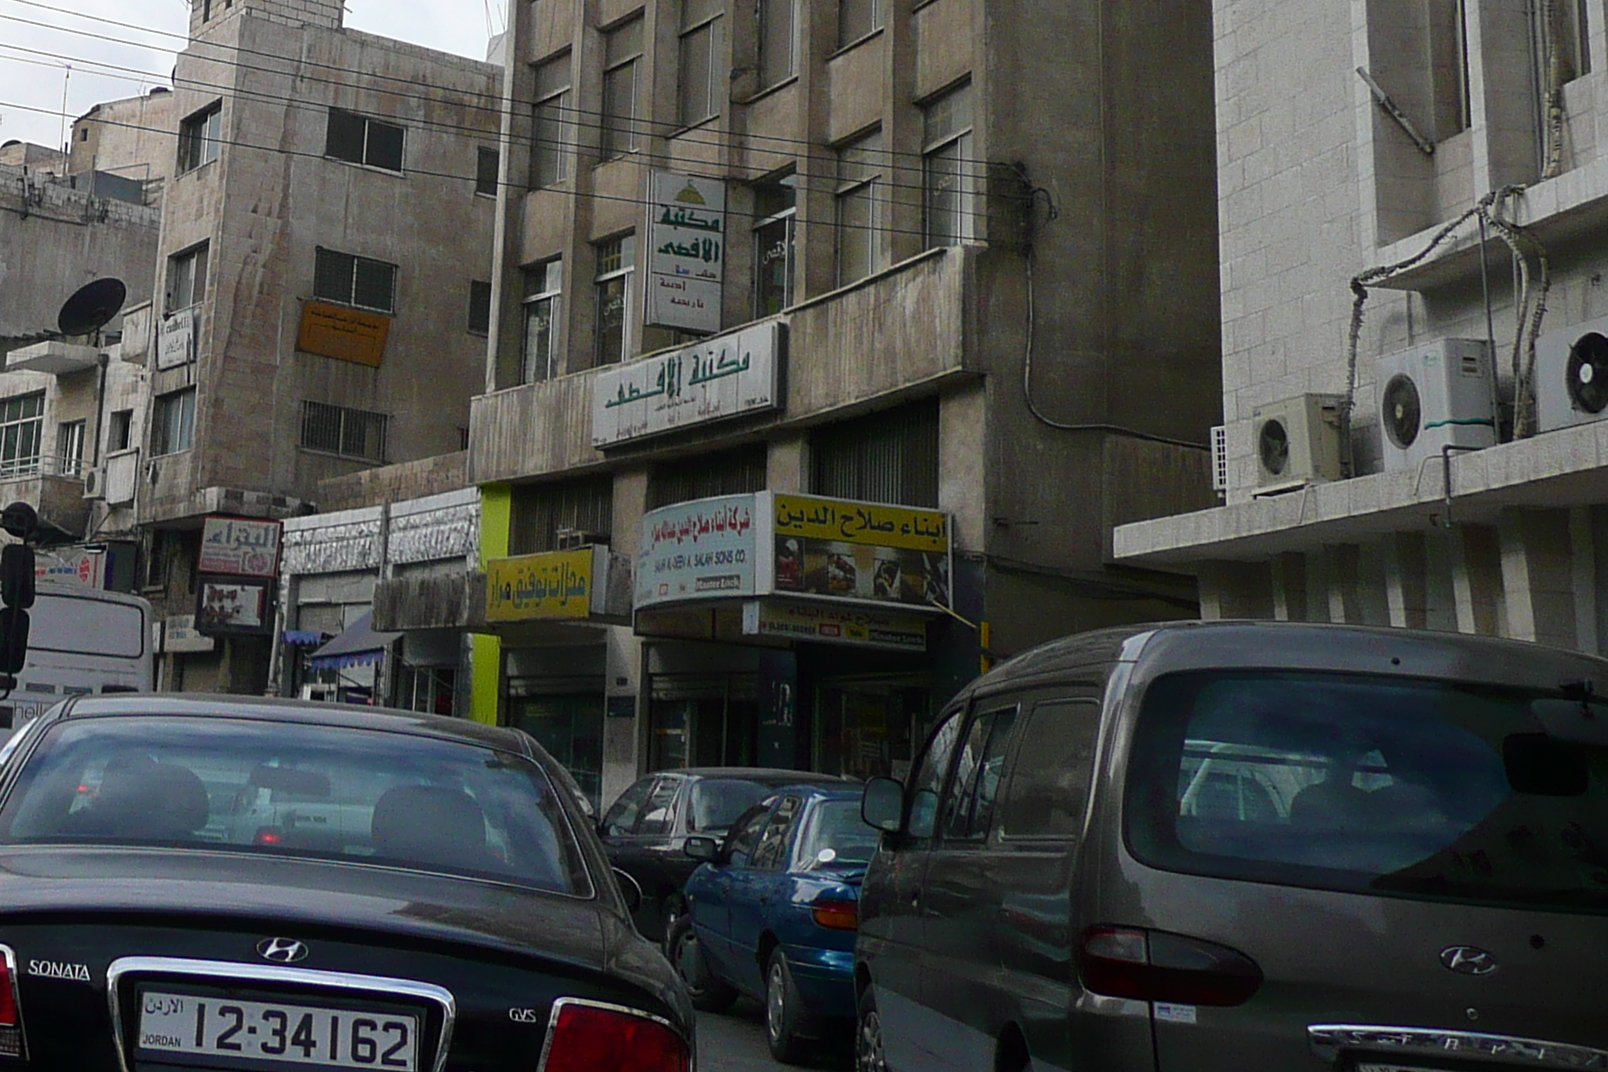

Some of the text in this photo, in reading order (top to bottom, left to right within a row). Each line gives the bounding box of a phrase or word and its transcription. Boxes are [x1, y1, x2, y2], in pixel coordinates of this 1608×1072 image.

[660, 204, 720, 233] مكتبة
[688, 348, 750, 389] مكتبة
[776, 502, 835, 530] الدين
[839, 508, 895, 538] صلاح
[13, 701, 51, 719] hell
[27, 958, 92, 982] SONATA
[142, 1033, 182, 1048] JORDAN
